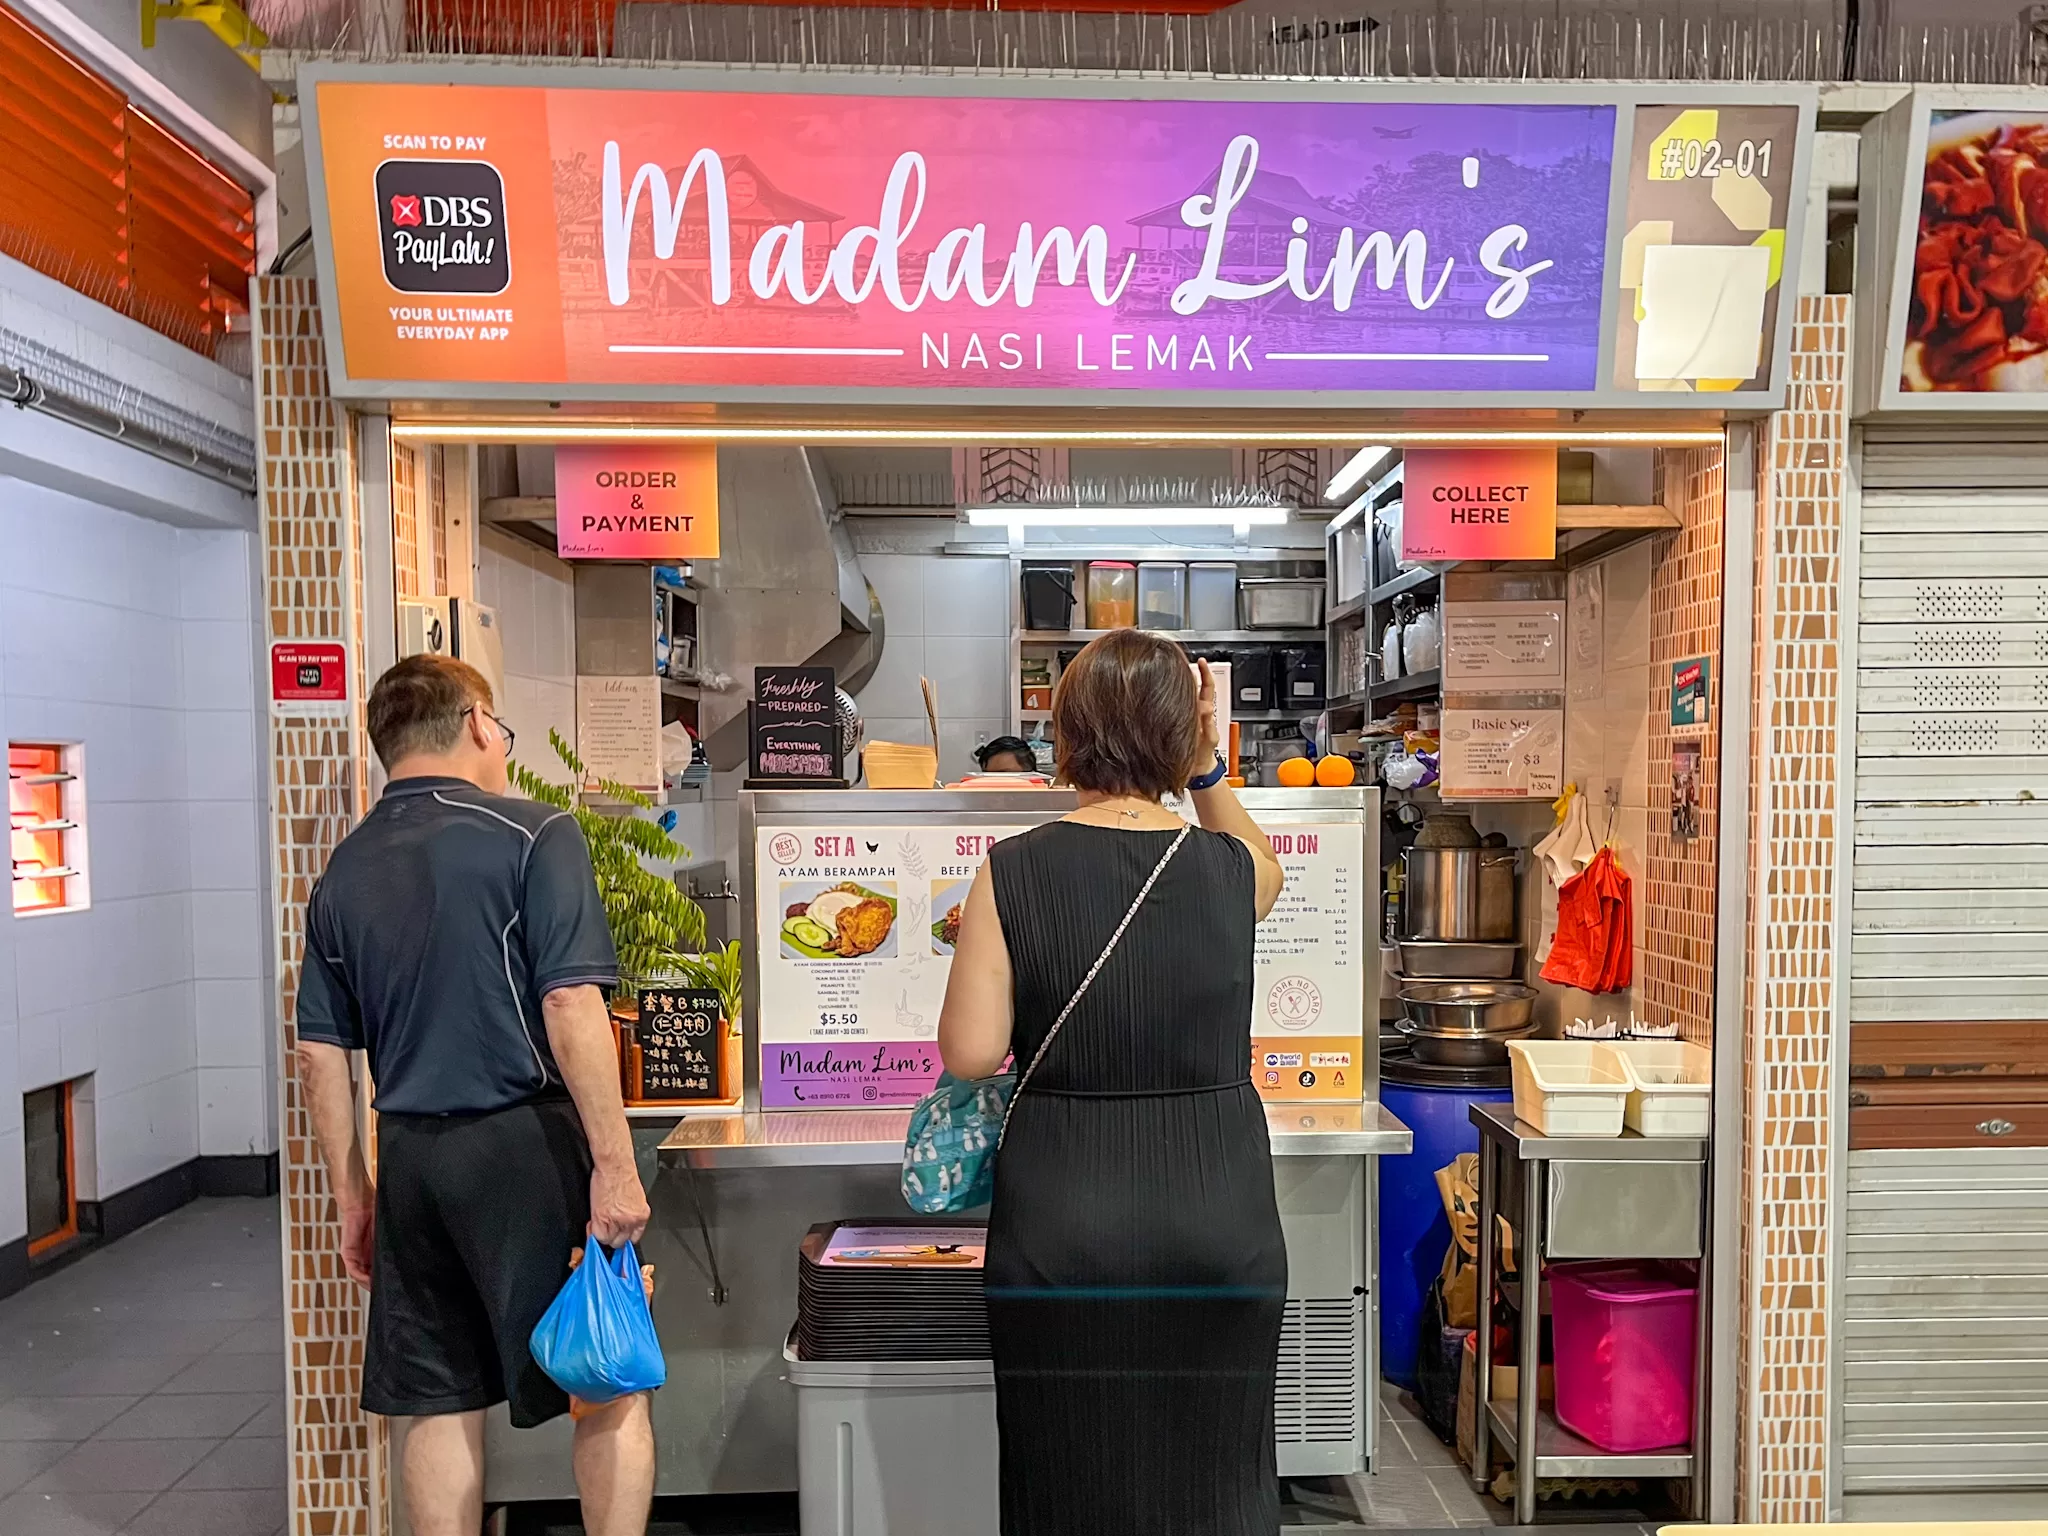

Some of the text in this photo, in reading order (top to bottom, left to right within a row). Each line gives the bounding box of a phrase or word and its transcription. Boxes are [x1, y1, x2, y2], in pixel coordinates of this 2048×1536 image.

[383, 135, 487, 151] SCAN TO PAY
[1661, 139, 1773, 178] #02-01
[424, 195, 492, 227] DBS
[603, 134, 1554, 319] Madam Lim's
[394, 230, 495, 271] PayLah!
[389, 306, 513, 323] YOUR ULTIMATE
[397, 325, 509, 341] EVERYDAY APP
[921, 332, 1255, 372] NASI LEMAK
[596, 472, 677, 488] ORDER
[630, 493, 644, 509] &
[1432, 486, 1529, 502] COLLECT
[582, 515, 694, 532] PAYMENT
[1451, 508, 1509, 523] HERE
[278, 655, 339, 663] SCAN TO PAY WITH
[761, 674, 824, 699] Freshly
[768, 701, 822, 713] PREPARED
[1472, 717, 1530, 730] Basic Set
[775, 839, 793, 851] BEST
[814, 836, 856, 857] SET A
[955, 836, 982, 856] SET
[1265, 834, 1319, 854] DD ON
[777, 848, 796, 859] SELLER
[778, 866, 896, 877] AYAM BERAMPAH
[941, 866, 971, 876] BEEF
[643, 991, 674, 1012] 套餐
[678, 997, 688, 1009] B
[1270, 980, 1320, 1014] NO PORK NO LARD
[656, 1016, 705, 1031] 仁当牛肉
[820, 1012, 858, 1026] $5.50
[780, 1046, 934, 1075] Madam Lim's
[854, 1075, 882, 1083] LEMAK
